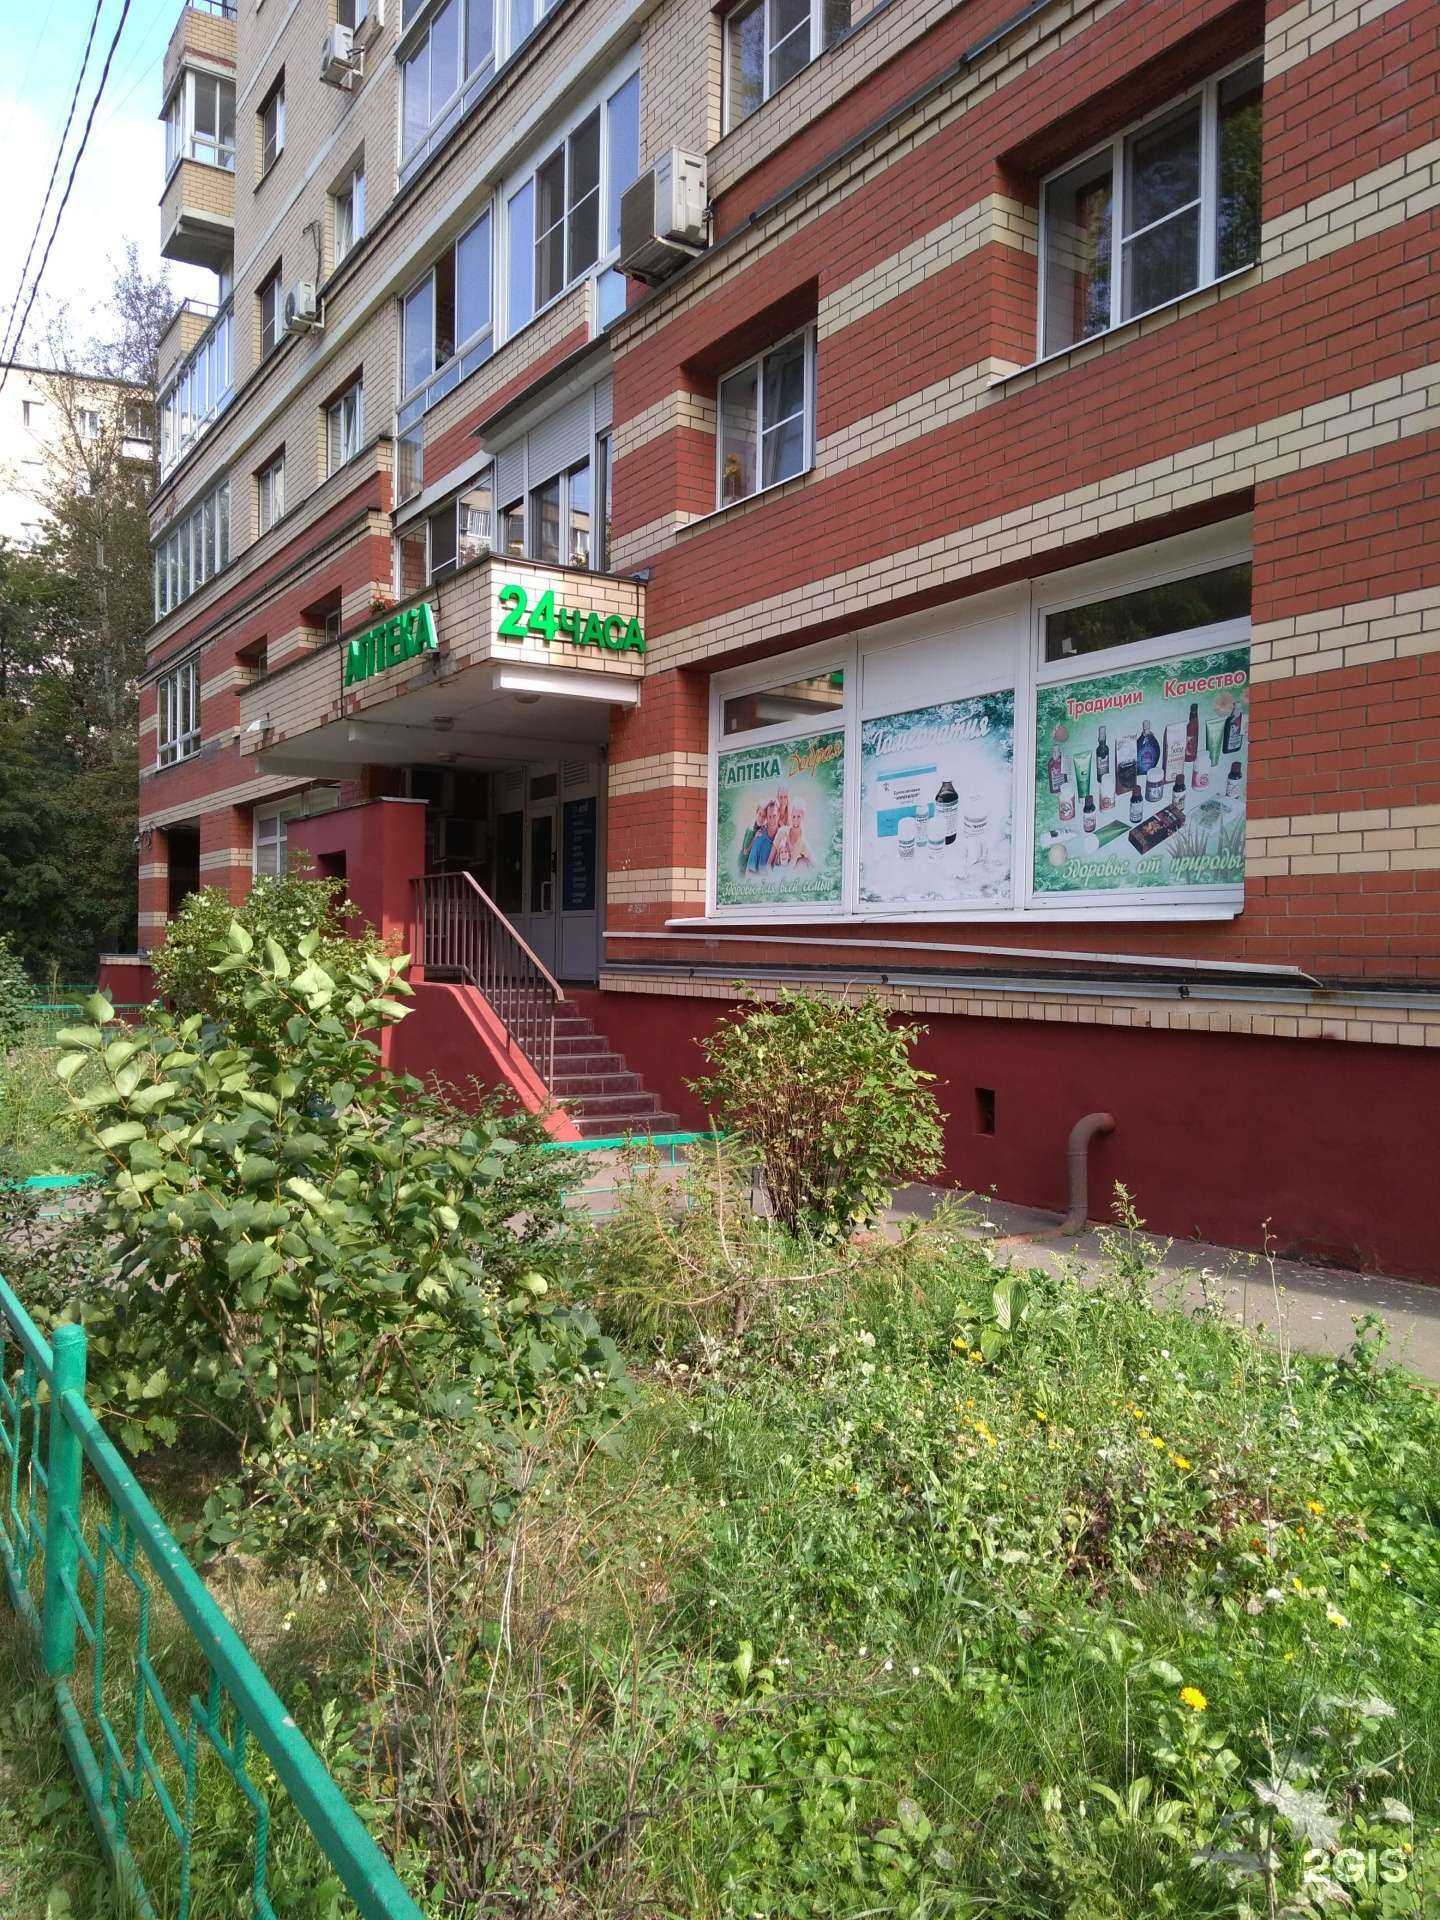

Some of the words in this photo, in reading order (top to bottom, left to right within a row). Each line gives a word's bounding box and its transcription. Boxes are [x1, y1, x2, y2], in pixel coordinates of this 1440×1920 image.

[498, 584, 559, 641] 24
[559, 608, 647, 654] ЧАСА
[344, 603, 440, 687] АПТЕКА
[1165, 671, 1246, 698] Качество
[1067, 691, 1143, 718] Традиции
[727, 758, 780, 784] АПТЕКА
[1062, 858, 1129, 886] Здоровье
[1137, 856, 1161, 874] от
[1170, 849, 1244, 880] природы
